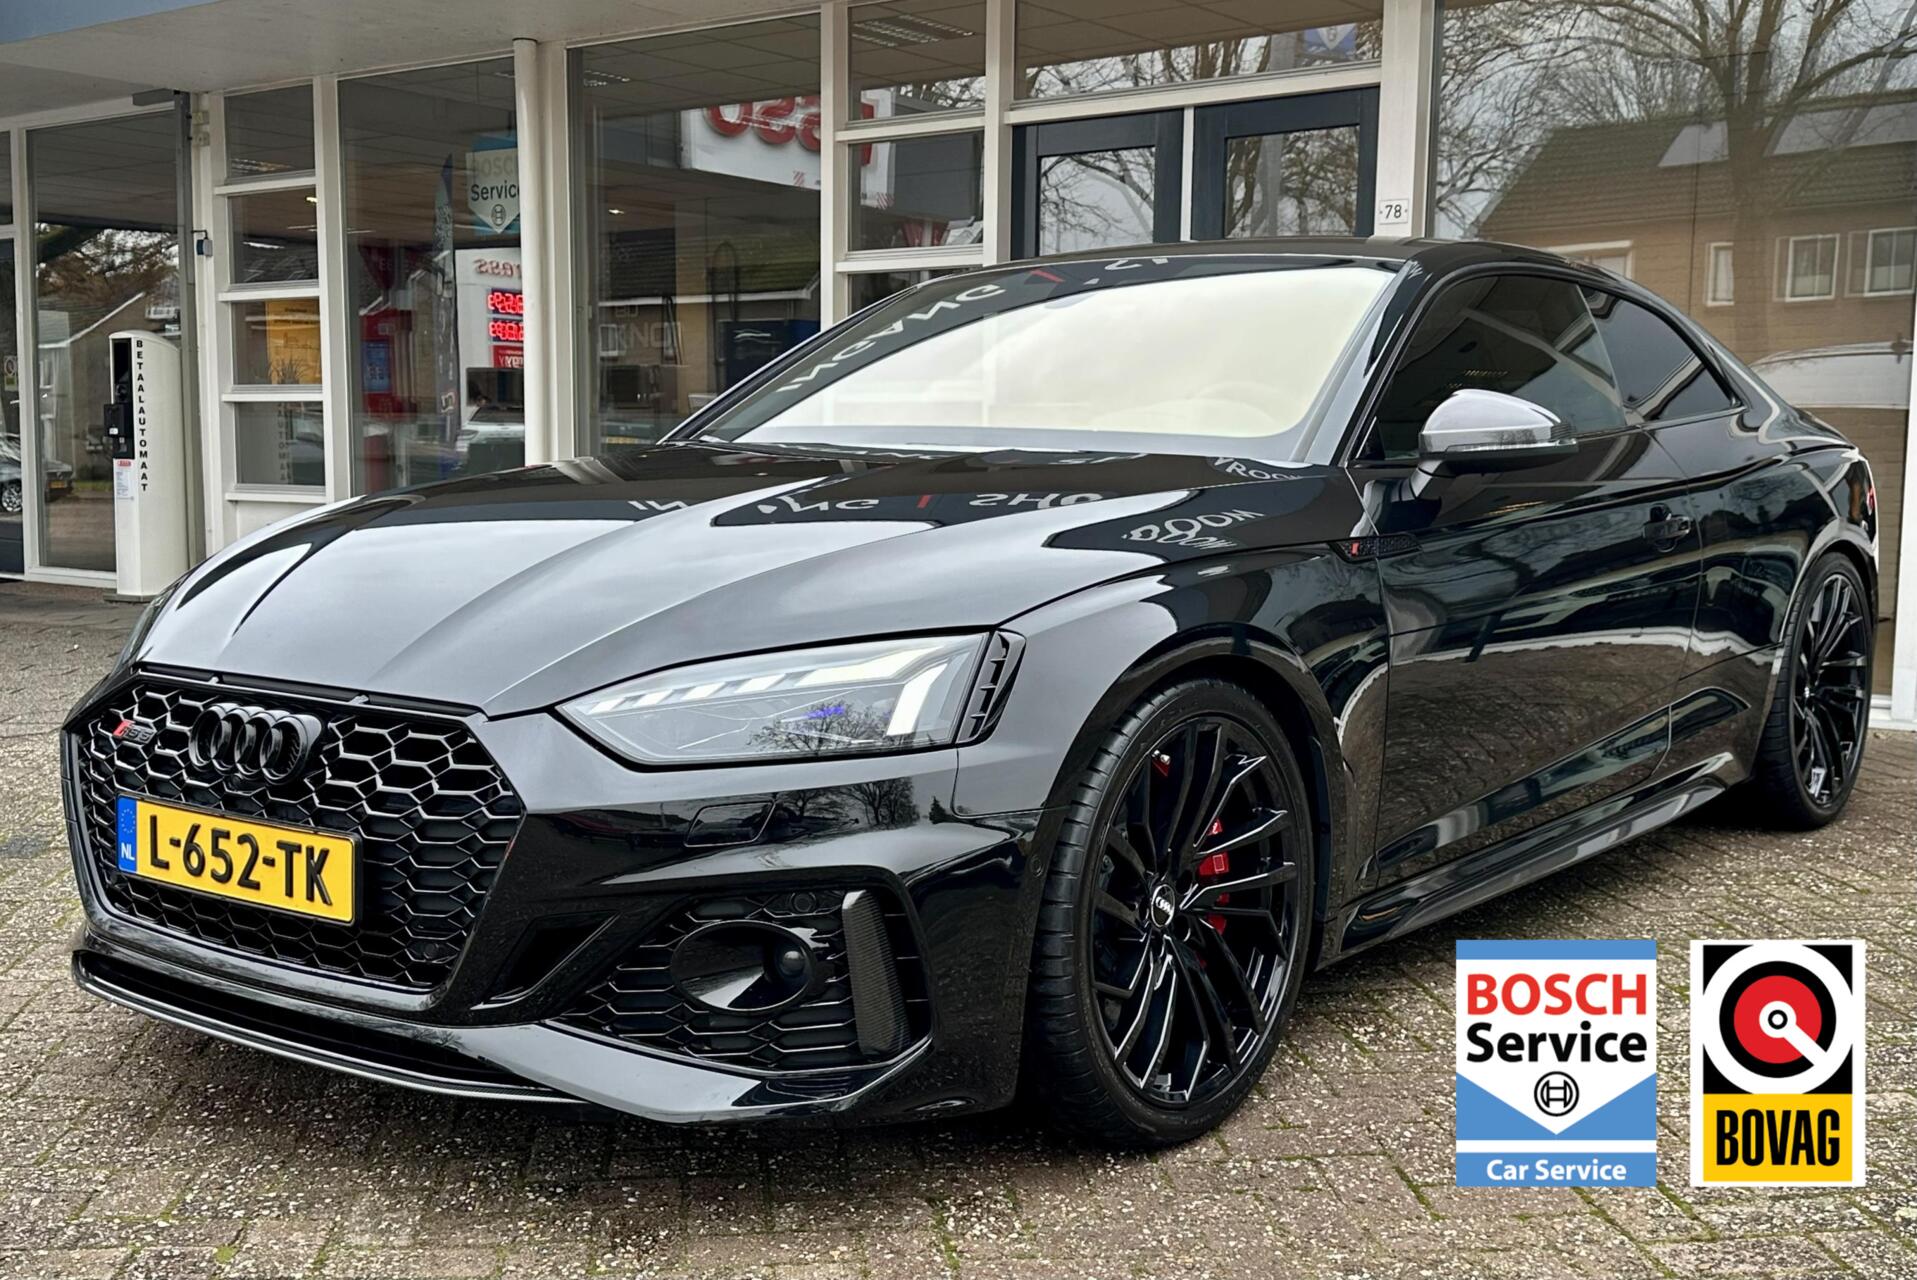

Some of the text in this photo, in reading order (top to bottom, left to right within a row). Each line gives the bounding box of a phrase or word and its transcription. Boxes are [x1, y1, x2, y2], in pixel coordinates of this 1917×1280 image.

[474, 154, 518, 178] OSC
[470, 179, 520, 202] Servic
[1385, 204, 1402, 219] 78
[136, 339, 148, 492] BETAALAUTOMAAT
[121, 842, 135, 861] NL
[149, 814, 333, 907] L-652-TK
